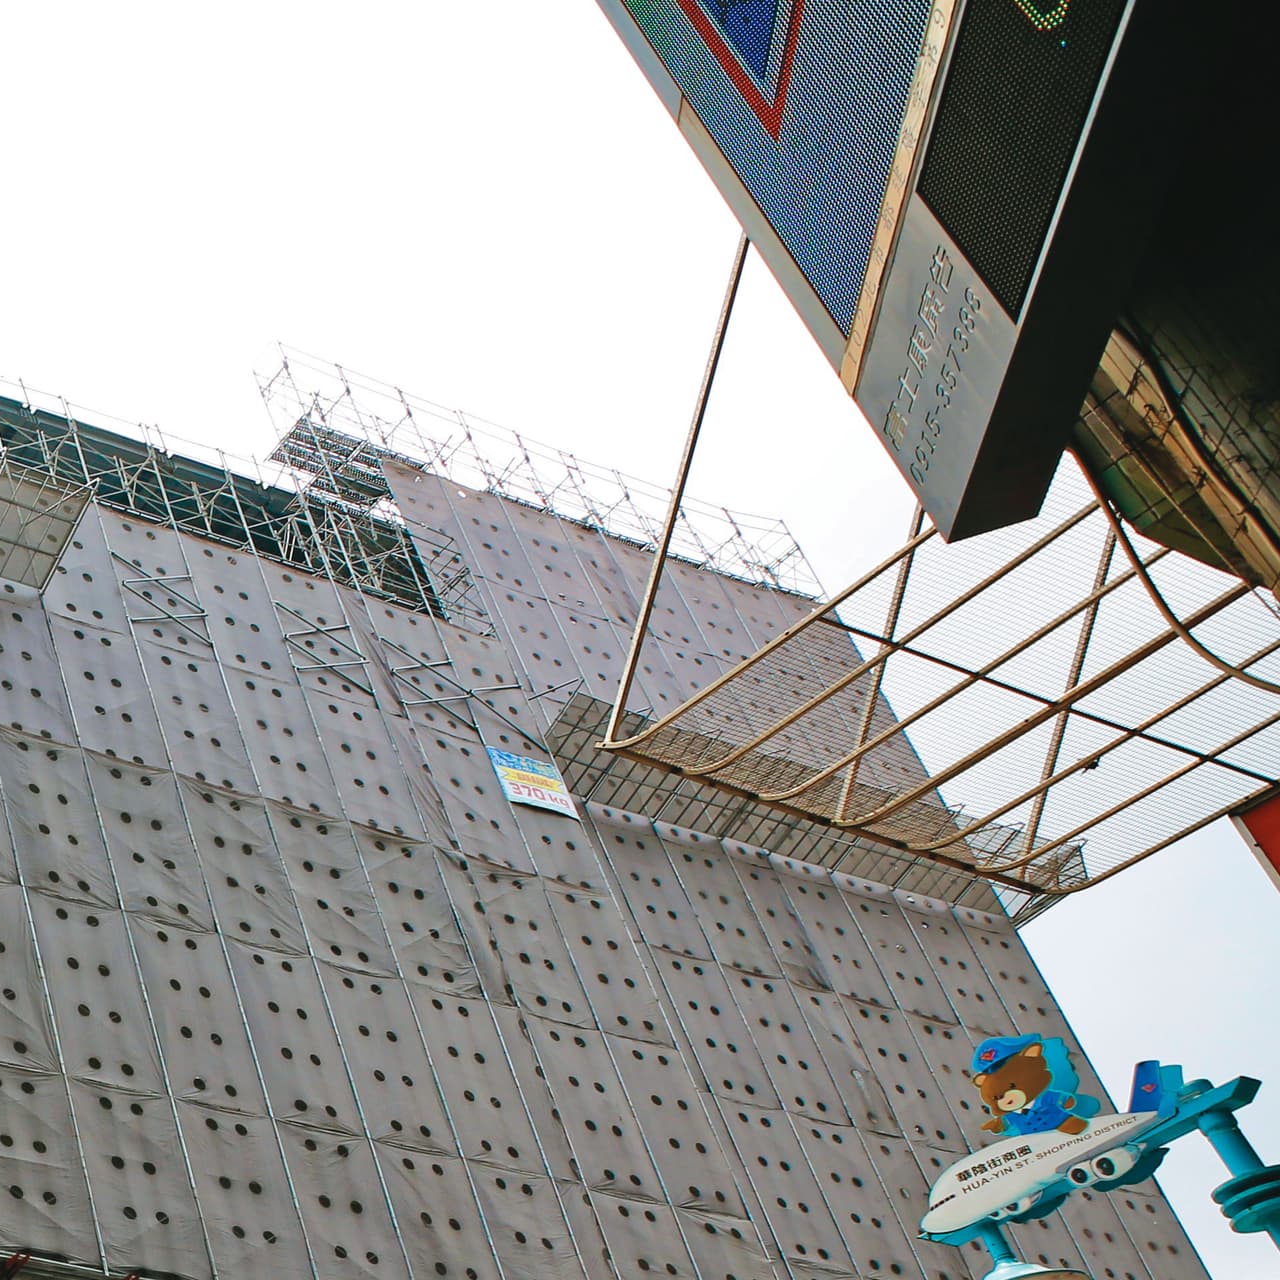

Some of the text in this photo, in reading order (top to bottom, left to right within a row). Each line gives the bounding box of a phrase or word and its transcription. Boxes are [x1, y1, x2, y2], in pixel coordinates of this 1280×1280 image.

[883, 244, 953, 451] 富士康廣告
[909, 287, 981, 486] 0915-357388
[956, 1145, 1032, 1182] 華陰街商圈
[962, 1116, 1138, 1194] HUA-YIN ST. SHOPPING DISTRICT
